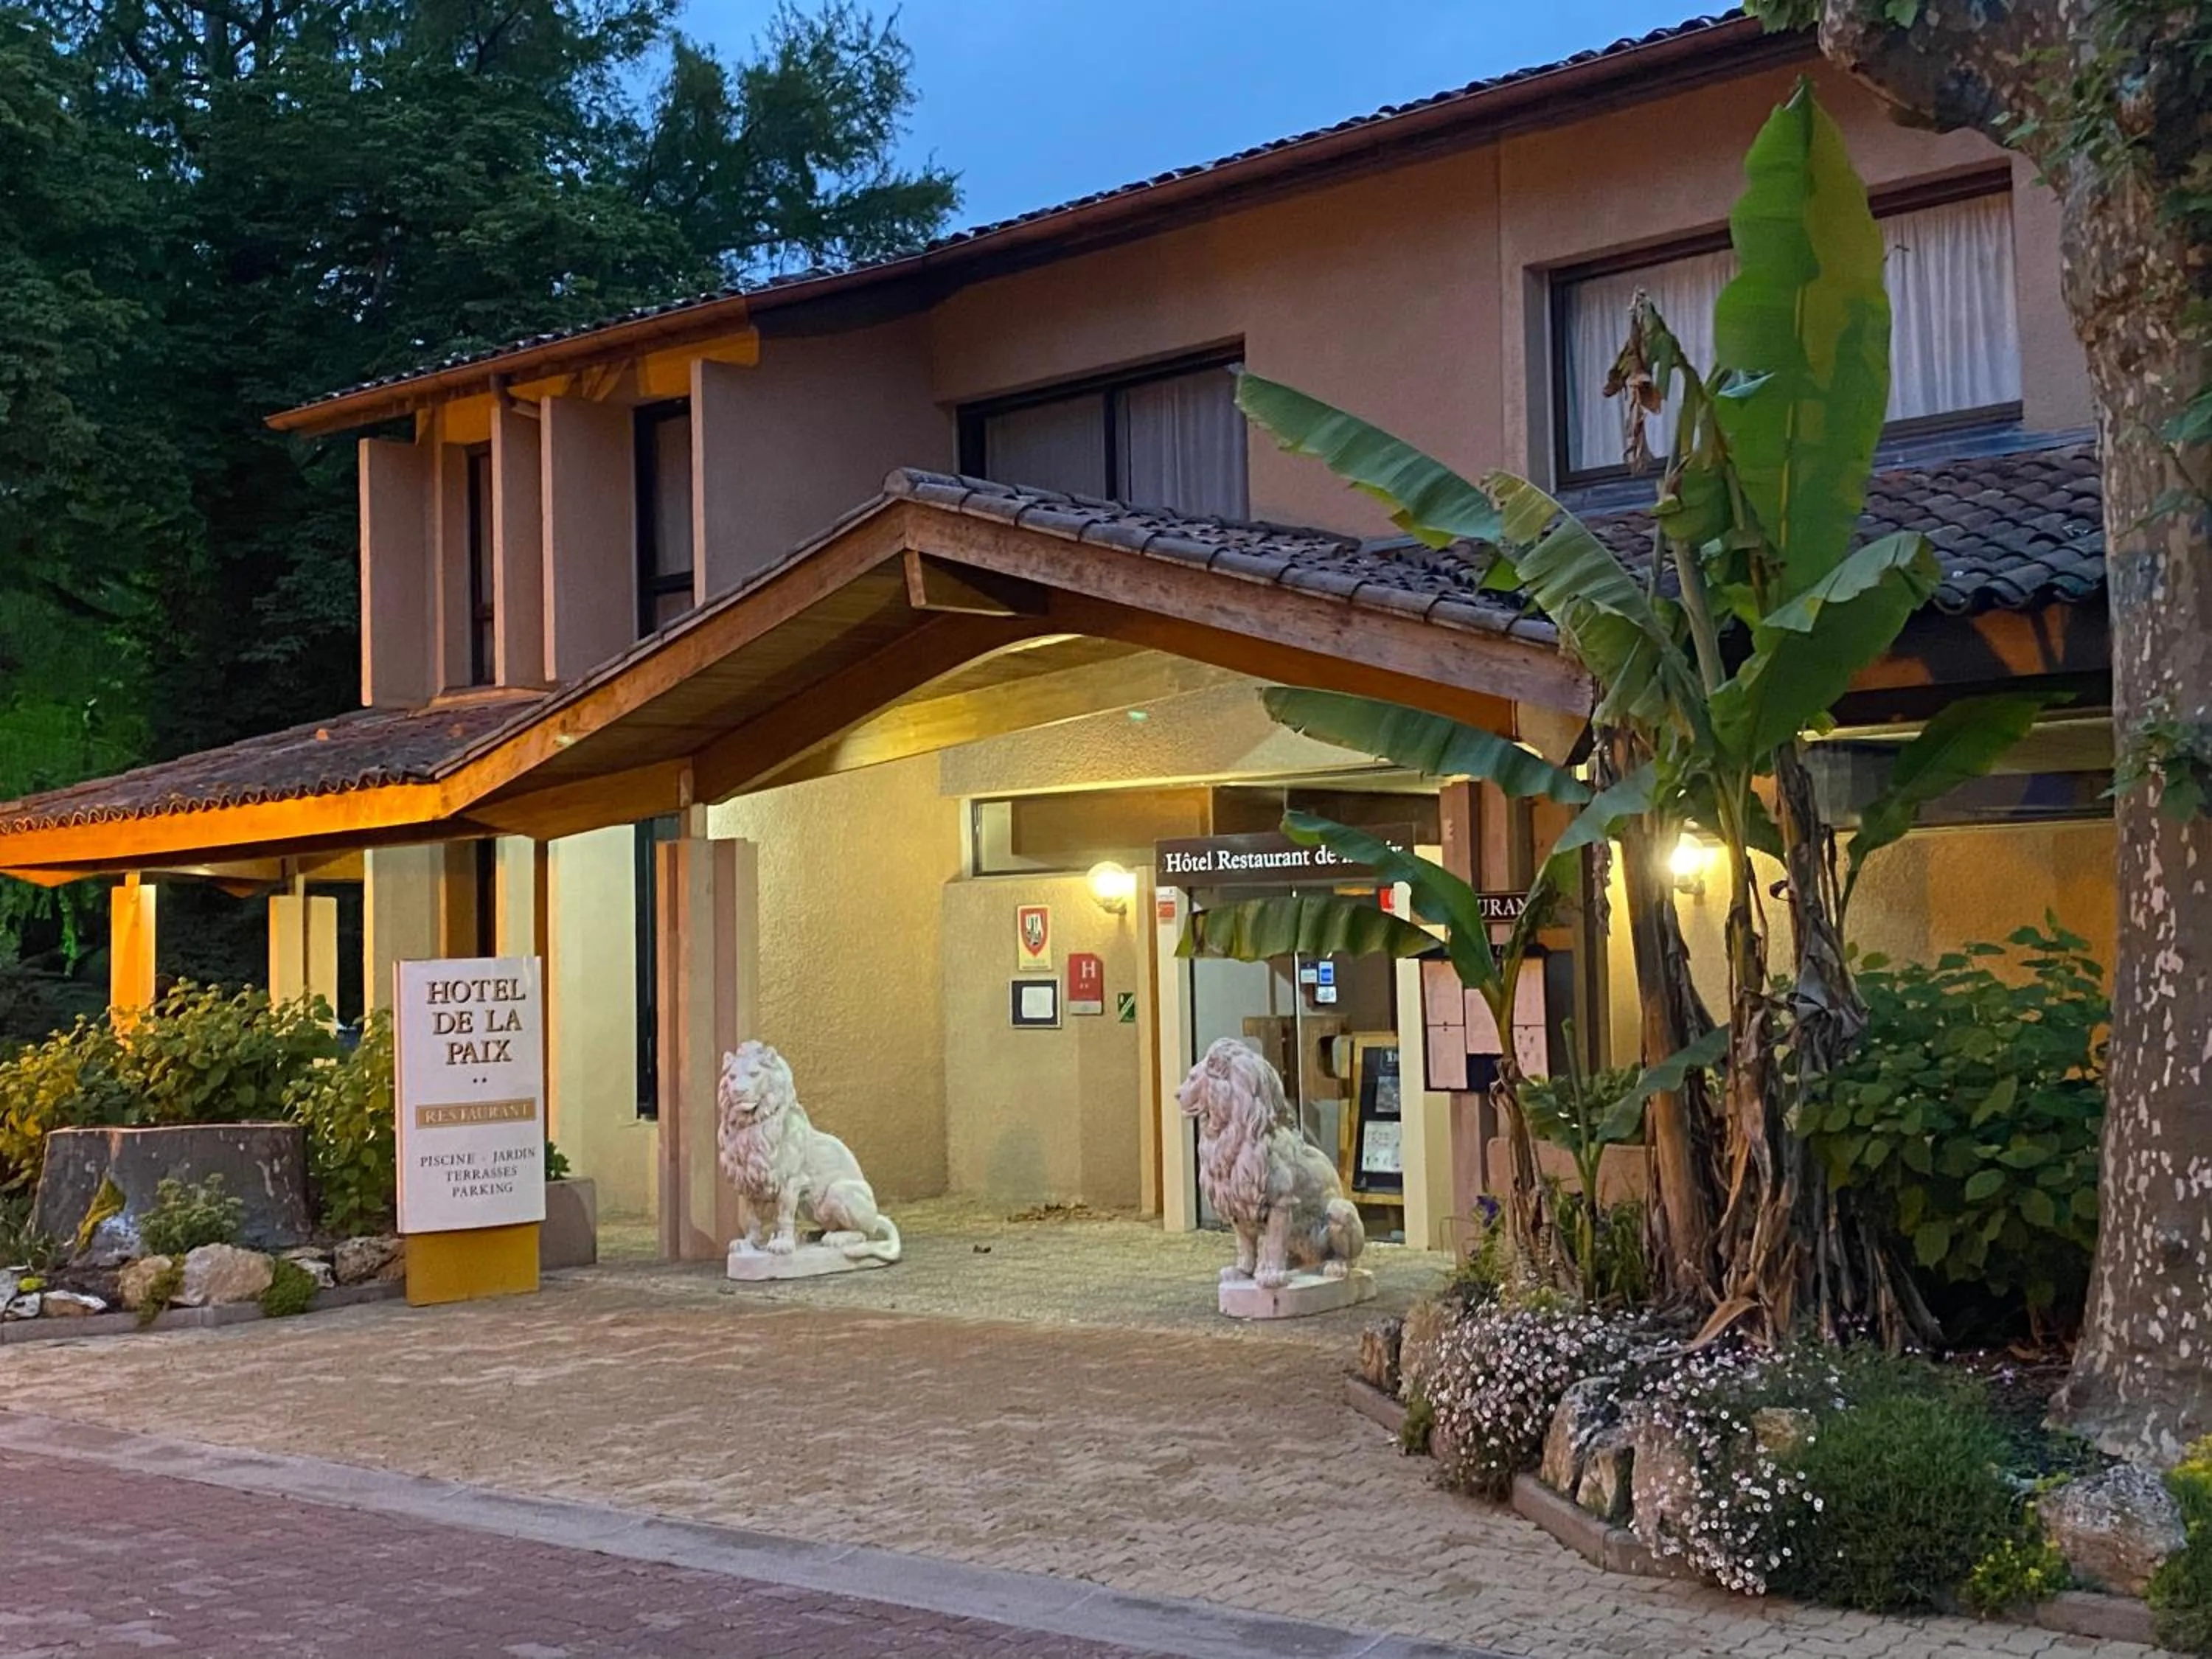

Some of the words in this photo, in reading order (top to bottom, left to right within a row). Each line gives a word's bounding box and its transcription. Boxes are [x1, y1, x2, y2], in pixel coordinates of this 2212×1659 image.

[1166, 850, 1212, 872] Hôtel
[1217, 849, 1310, 871] Restaurant
[1315, 844, 1337, 865] de
[1082, 960, 1096, 979] H
[426, 978, 526, 1004] HOTEL
[432, 1011, 473, 1035] DE
[484, 1008, 523, 1032] LA
[445, 1039, 512, 1065] PAIX
[425, 1104, 529, 1124] RESTAURANT
[420, 1152, 476, 1168] PISCINE
[493, 1147, 536, 1164] JARDIN
[445, 1165, 518, 1182] TERRASSES
[451, 1182, 513, 1198] PARKING
